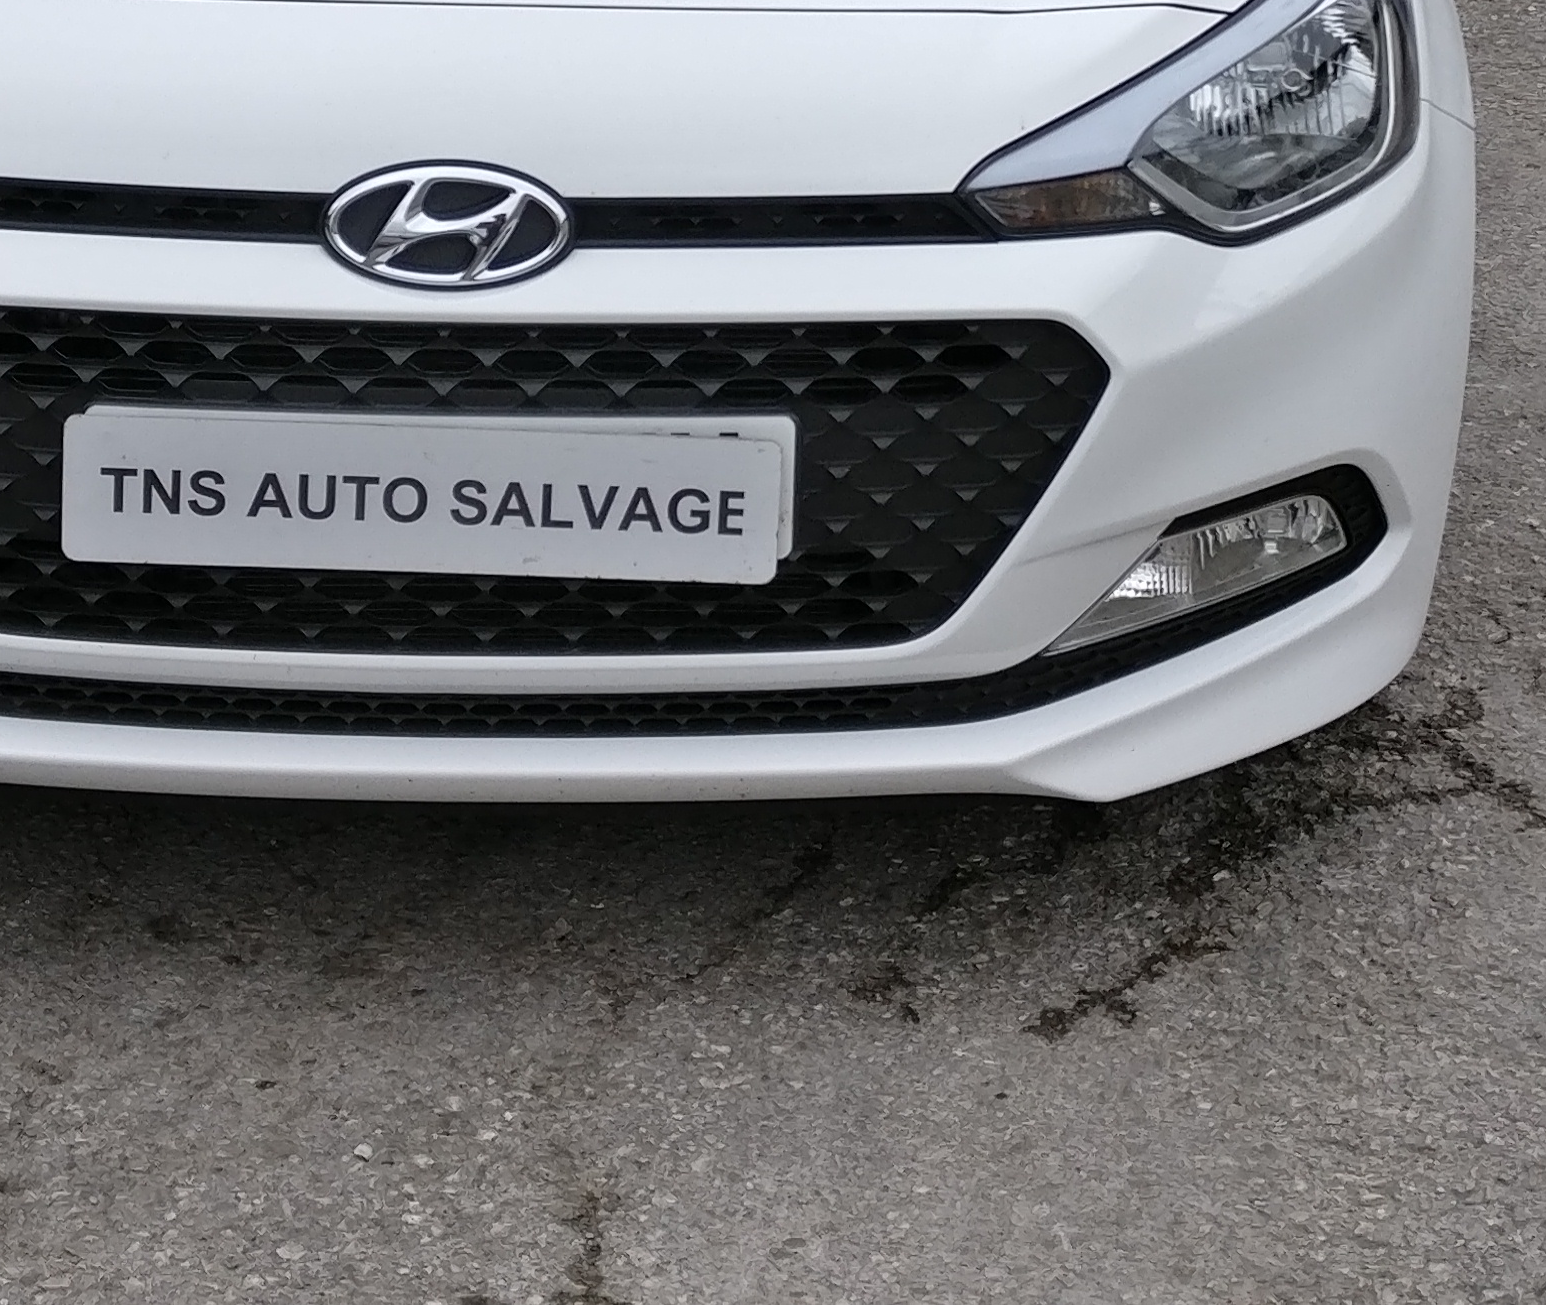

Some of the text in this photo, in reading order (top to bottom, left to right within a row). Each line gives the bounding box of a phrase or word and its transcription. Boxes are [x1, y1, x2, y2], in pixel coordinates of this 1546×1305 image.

[99, 466, 746, 538] TNS AUTO SALVAGE
